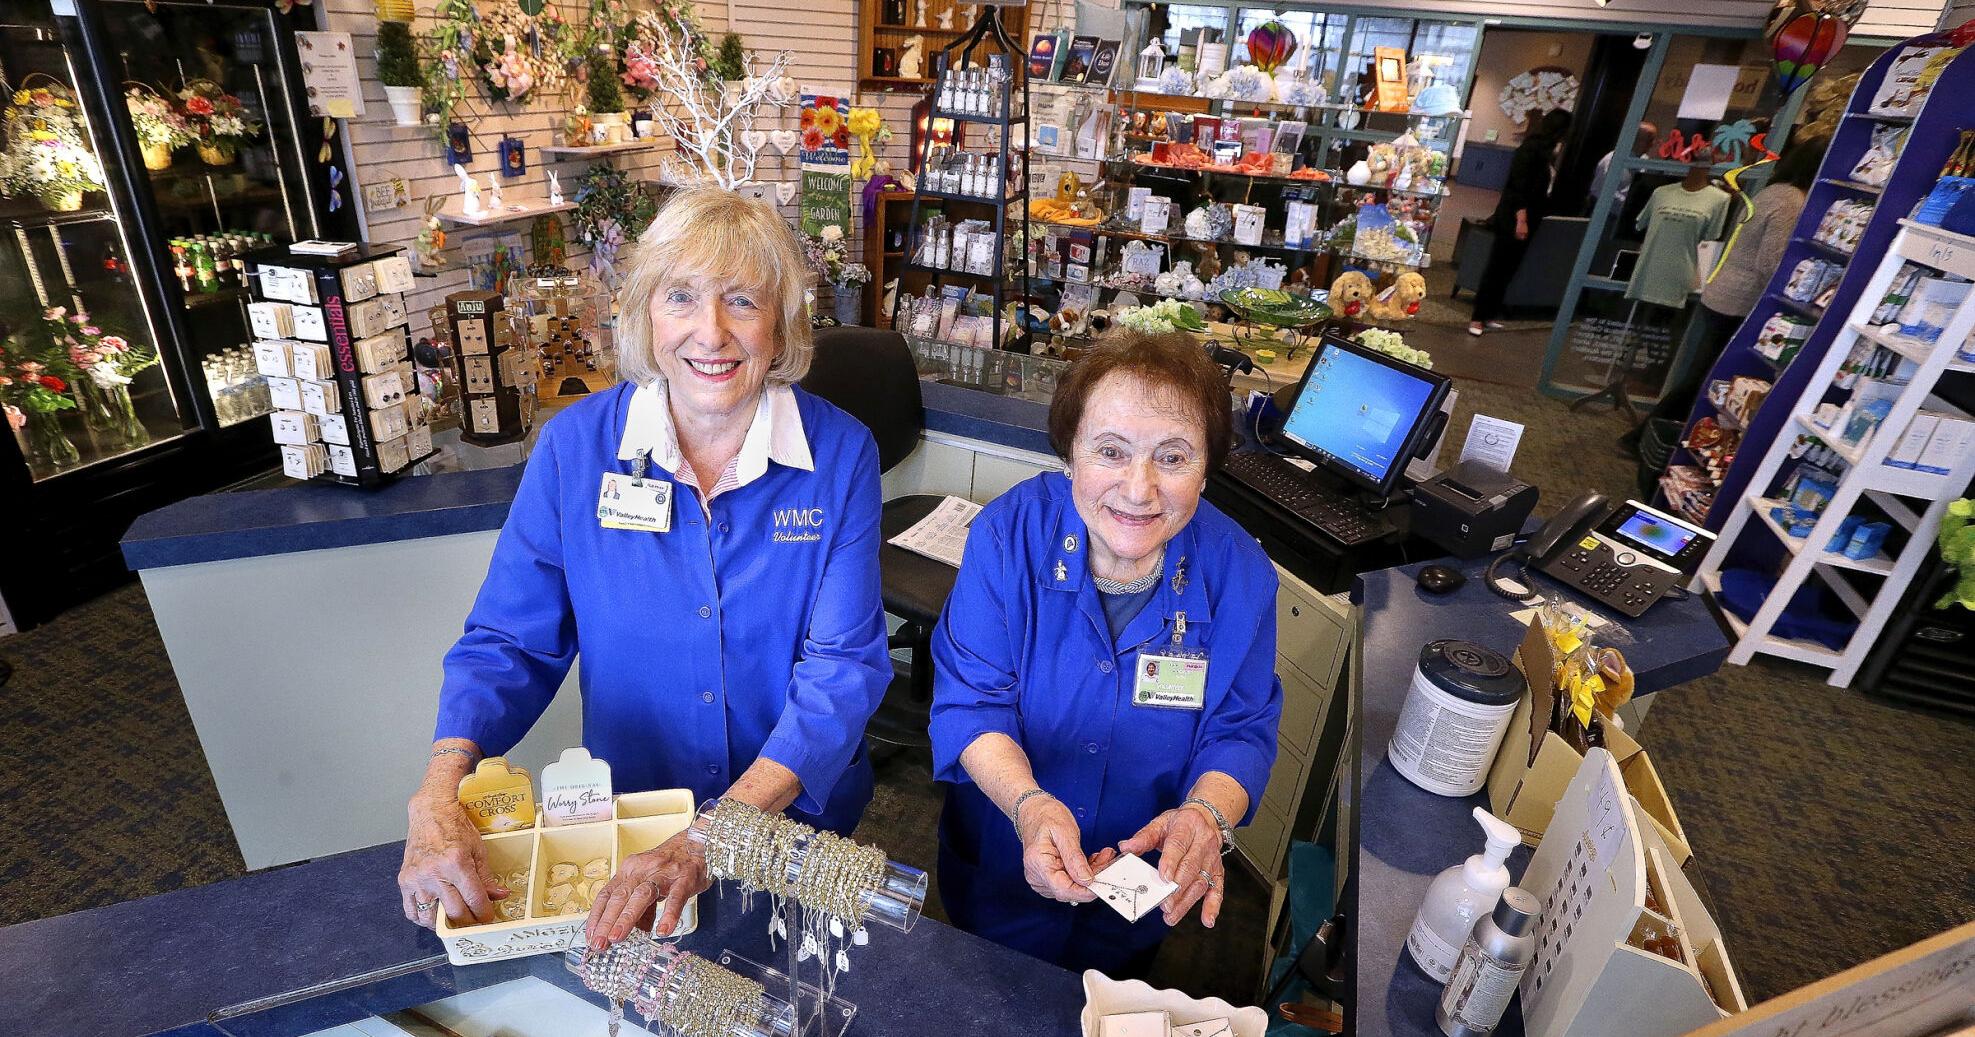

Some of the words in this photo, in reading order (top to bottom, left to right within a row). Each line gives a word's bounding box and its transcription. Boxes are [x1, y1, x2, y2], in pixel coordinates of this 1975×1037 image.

[807, 176, 844, 192] WELCOME
[810, 206, 841, 221] GARDEN
[324, 295, 356, 372] essentials
[773, 508, 824, 527] WMC
[773, 531, 821, 542] Volunteer
[465, 793, 526, 811] COMFORT
[547, 793, 578, 814] Worry
[579, 788, 611, 807] Stone
[478, 802, 517, 818] CROSS
